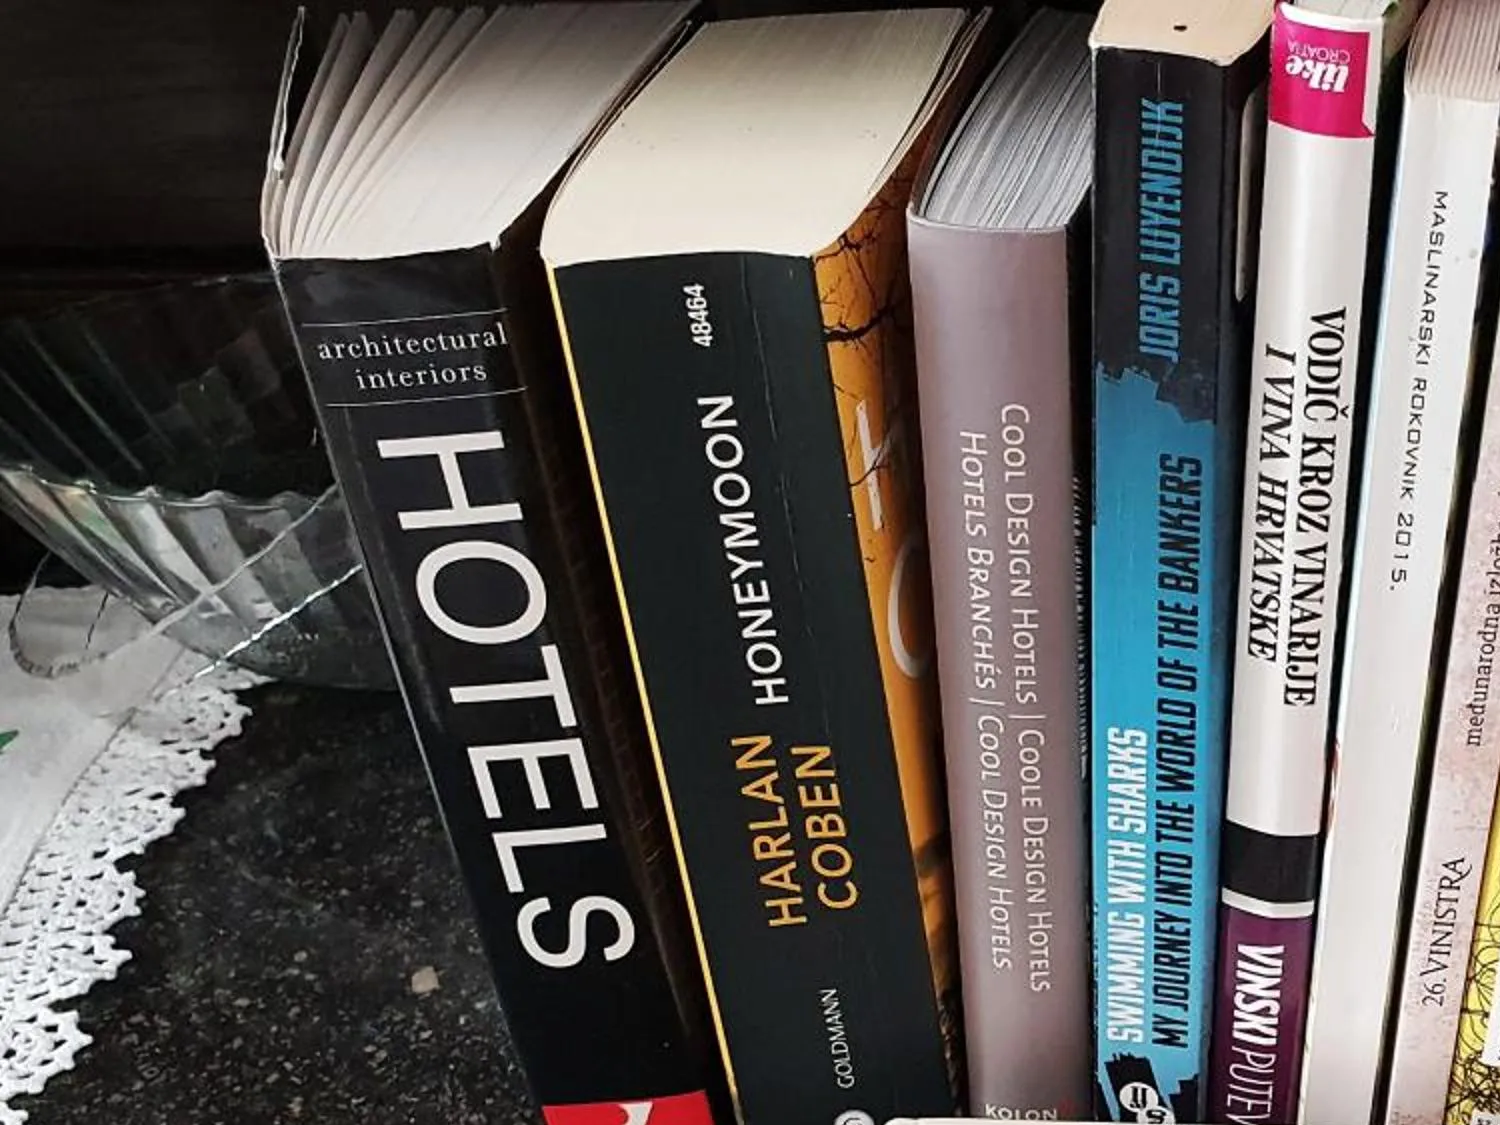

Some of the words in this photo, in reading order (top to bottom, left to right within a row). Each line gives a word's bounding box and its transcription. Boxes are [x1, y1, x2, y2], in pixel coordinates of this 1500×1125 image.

[1285, 55, 1349, 93] like
[1287, 39, 1351, 65] CROATIA
[1139, 97, 1183, 266] LUYENDIJK
[682, 283, 713, 348] 48464
[1139, 272, 1181, 363] JORIS
[1415, 190, 1449, 365] MASLINARSKI
[318, 322, 509, 360] architectural
[356, 360, 488, 391] interiors
[1265, 343, 1297, 367] I
[1304, 306, 1350, 423] VODIČ
[1001, 403, 1030, 482] COOL
[1259, 375, 1296, 462] VINA
[1401, 377, 1428, 499] ROKOVNIK
[959, 431, 988, 538] HOTELS
[1158, 453, 1203, 595] BANKERS
[1296, 432, 1337, 534] KROZ
[697, 395, 790, 705] HONEYMOON
[1005, 492, 1034, 598] DESIGN
[1247, 471, 1288, 663] HRVATSKE
[1011, 609, 1040, 704] HOTELS
[1158, 599, 1199, 652] THE
[1283, 542, 1329, 707] VINARIJE
[377, 431, 636, 969] HOTELS
[1157, 656, 1198, 693] OF
[977, 714, 1004, 781] COOL
[1017, 728, 1045, 809] COOLE
[1108, 726, 1148, 836] SHARKS
[1156, 697, 1198, 793] WORLD
[730, 735, 808, 927] HARLAN
[790, 744, 860, 910] COBEN
[982, 788, 1008, 879] DESIGN
[1022, 816, 1049, 904] DESIGN
[1156, 799, 1195, 844] THE
[1107, 838, 1147, 904] WITH
[1154, 851, 1194, 907] INTO
[988, 886, 1014, 971] HOTELS
[1027, 910, 1053, 993] HOTELS
[1152, 910, 1192, 1013] JOURNEY
[1106, 911, 1145, 1044] SWIMMING
[1231, 943, 1285, 1046] VINSKI
[819, 988, 855, 1088] GOLDMANN
[1150, 1016, 1190, 1049] MY
